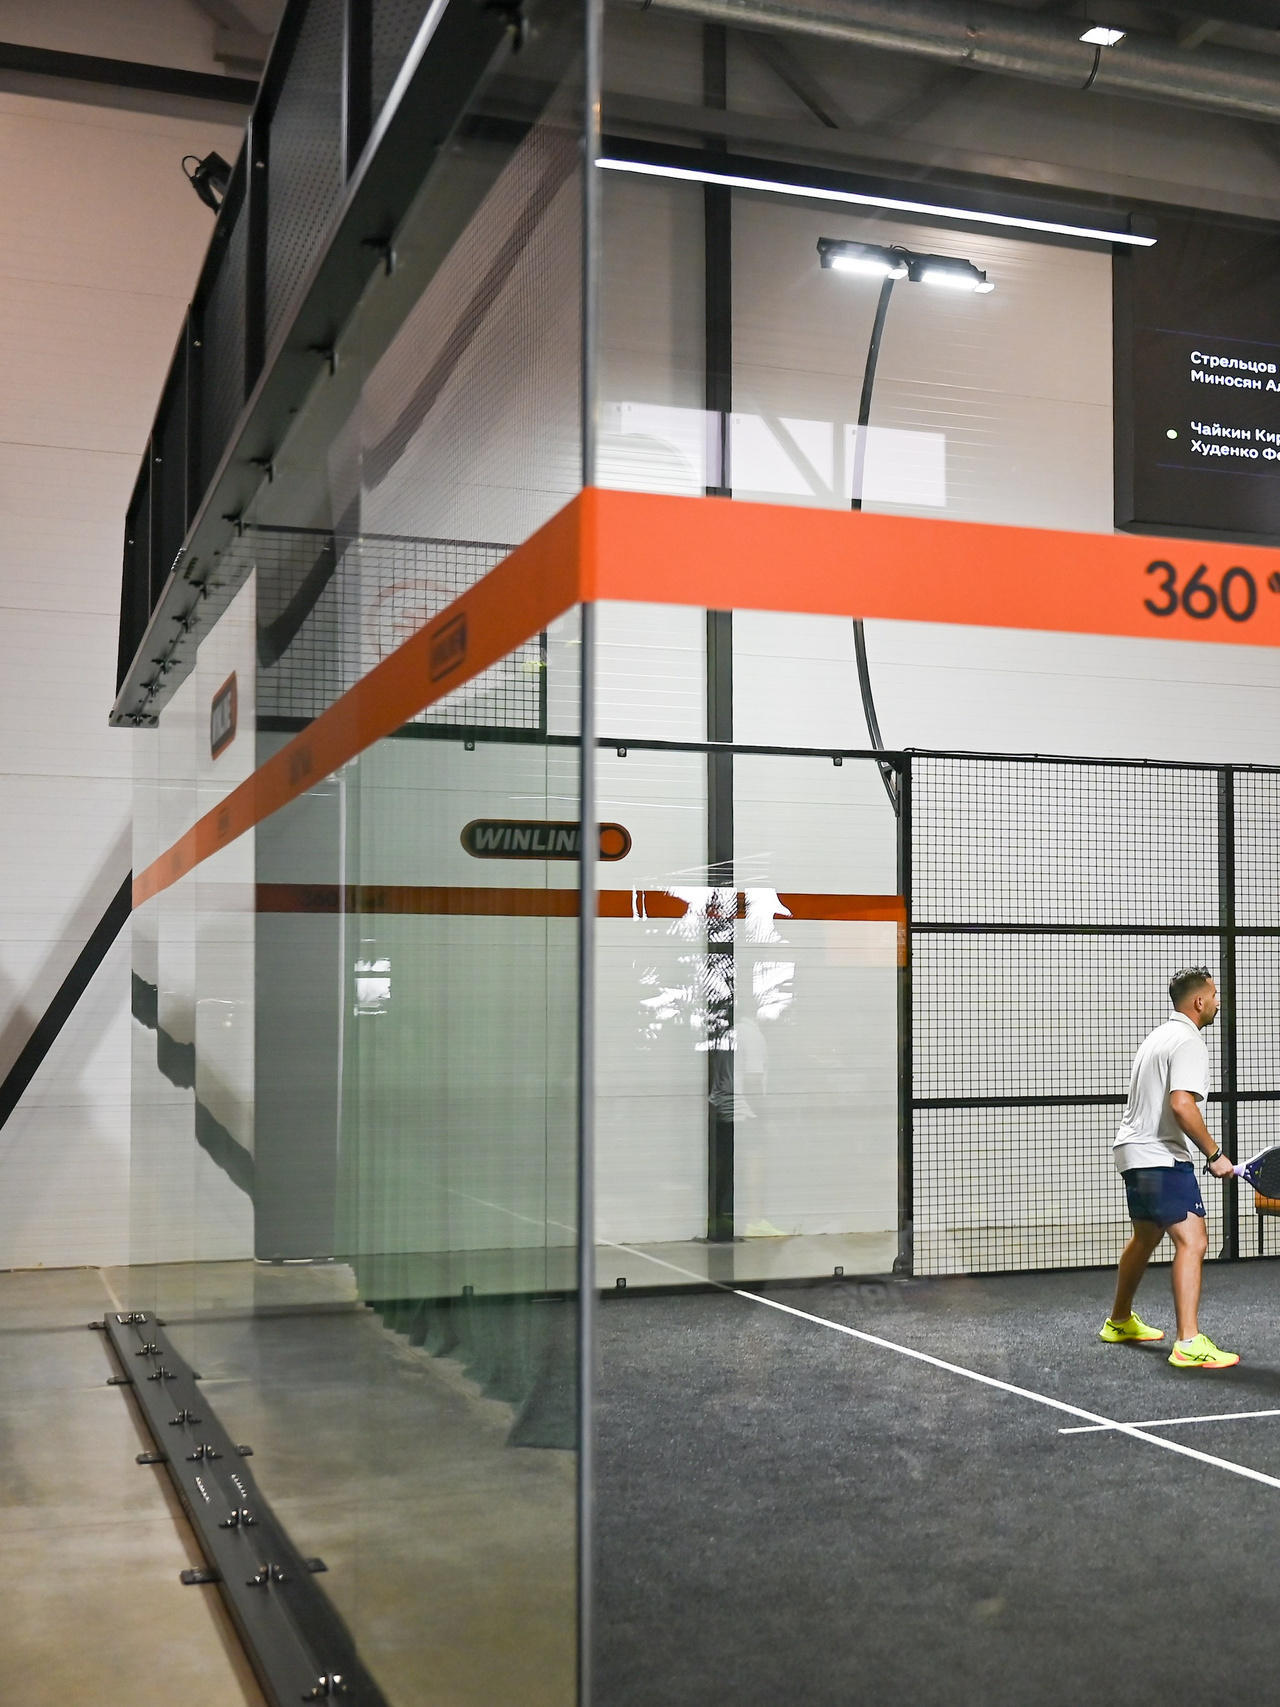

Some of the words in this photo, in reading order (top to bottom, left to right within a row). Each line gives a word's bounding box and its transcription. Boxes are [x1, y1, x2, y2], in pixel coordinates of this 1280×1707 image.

[1190, 351, 1277, 373] Стрельцов
[1190, 369, 1262, 390] Миносян
[1190, 421, 1251, 440] Чайкин
[1190, 439, 1259, 459] Худенко
